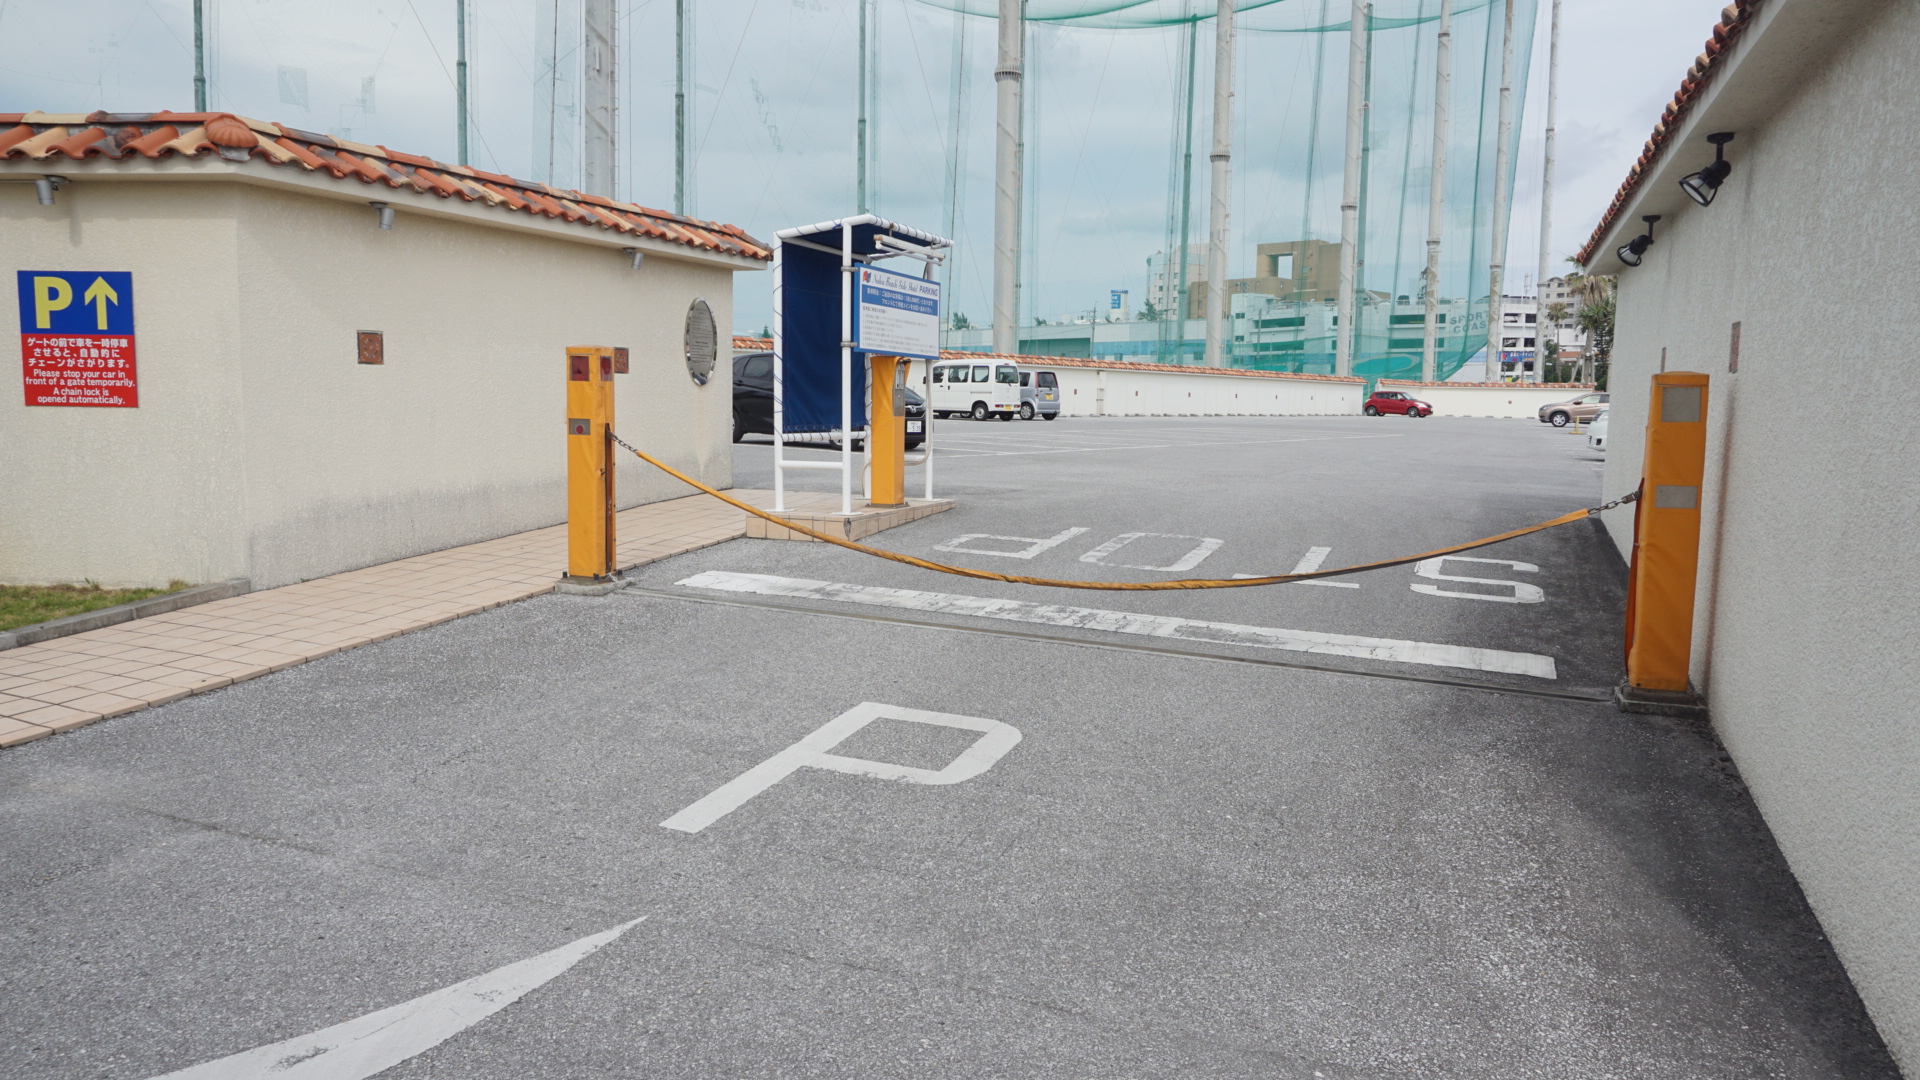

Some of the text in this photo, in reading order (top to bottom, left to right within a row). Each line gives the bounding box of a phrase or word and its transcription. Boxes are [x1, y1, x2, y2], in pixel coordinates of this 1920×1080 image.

[919, 285, 938, 297] PARKING
[33, 276, 73, 329] P
[1449, 310, 1490, 325] SPORT
[1453, 320, 1487, 334] COAS
[27, 338, 128, 348] ゲートの前で車を一時停車
[33, 348, 120, 357] させると、自動的に
[28, 358, 130, 368] チェーンがさがります。
[33, 369, 60, 377] Please
[63, 370, 80, 378] stop
[82, 371, 100, 379] your
[118, 370, 125, 378] in
[25, 377, 46, 385] front
[48, 377, 57, 385] of
[67, 378, 85, 387] gate
[87, 378, 135, 387] temporarily.
[53, 387, 60, 395] A
[61, 387, 82, 395] chain
[84, 387, 100, 395] lock
[37, 395, 125, 404] opened automatically.
[933, 527, 1545, 604] STOP
[658, 701, 1023, 833] P
